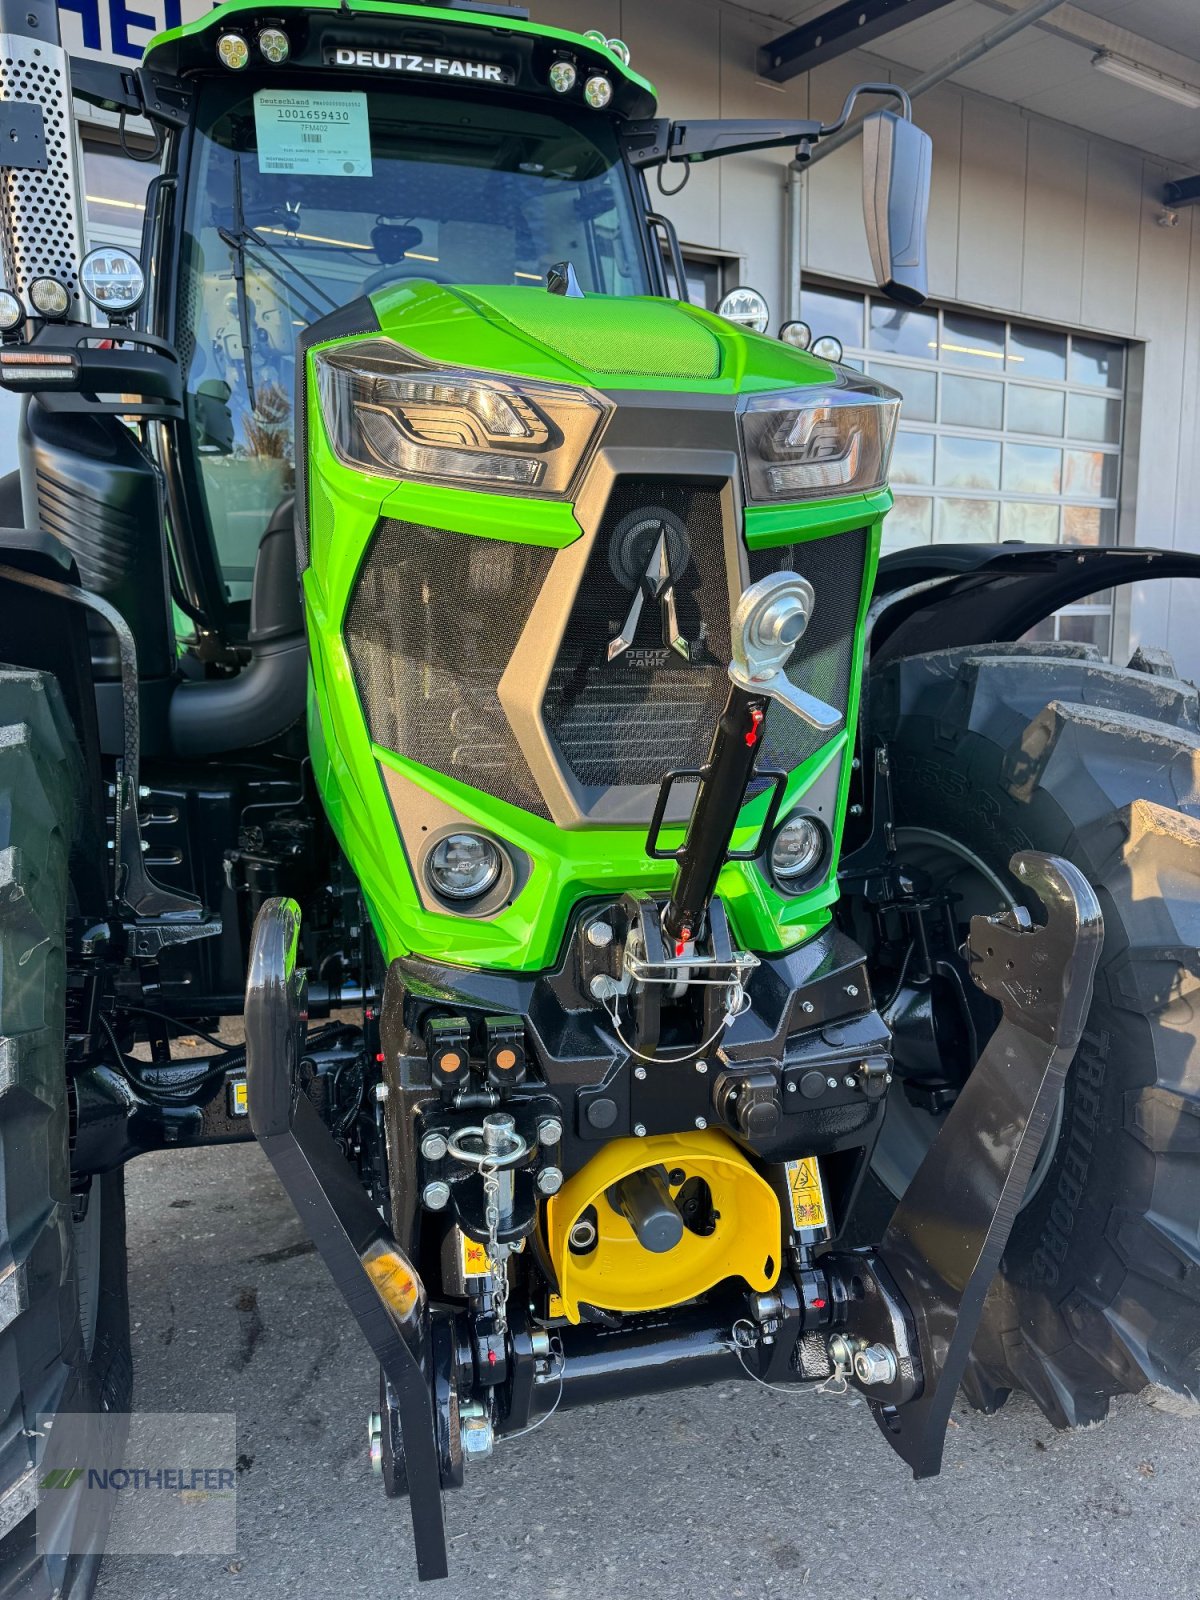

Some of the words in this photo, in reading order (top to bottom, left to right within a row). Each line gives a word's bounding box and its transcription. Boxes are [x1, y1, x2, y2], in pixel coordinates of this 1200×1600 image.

[336, 49, 501, 80] DEUTZ-FAHR
[277, 109, 349, 120] 1001659430
[625, 650, 671, 659] DEUTZ
[628, 658, 666, 667] FAHR
